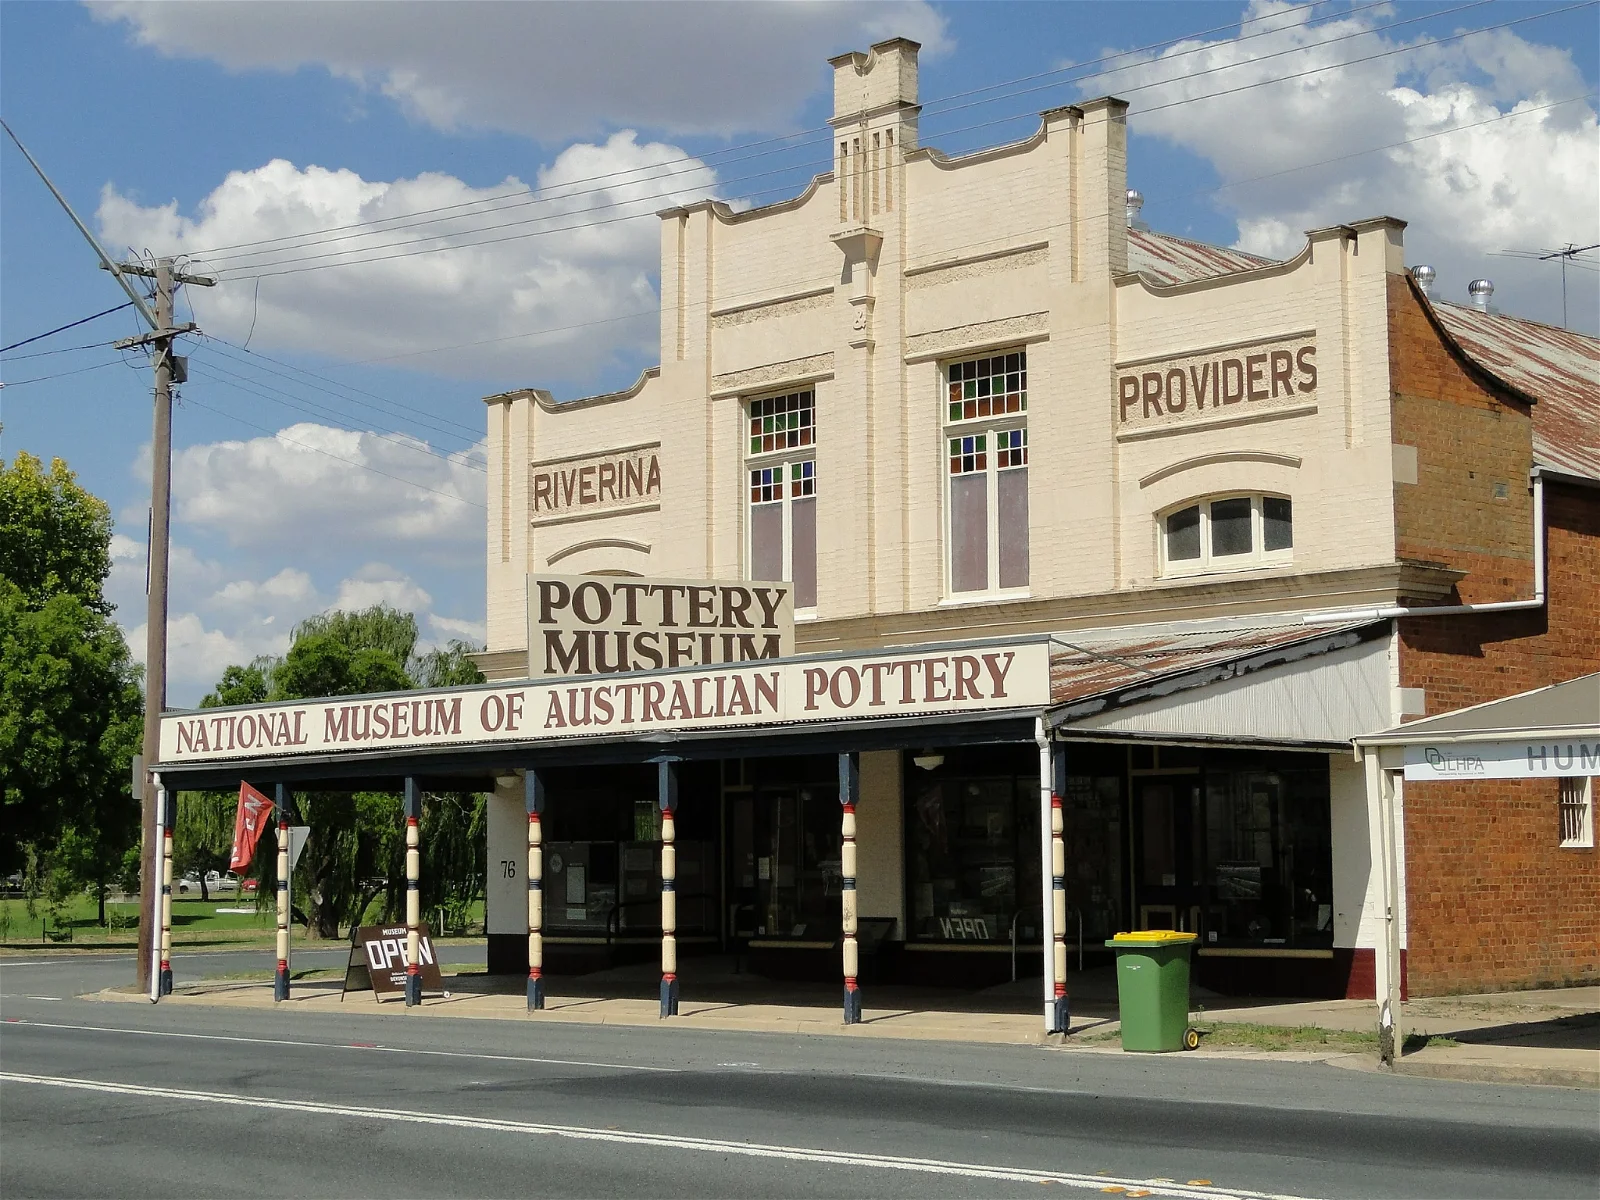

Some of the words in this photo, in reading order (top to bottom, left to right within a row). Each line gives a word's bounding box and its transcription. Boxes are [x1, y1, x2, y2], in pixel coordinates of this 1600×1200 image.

[1119, 345, 1318, 423] PROVIDERS
[534, 454, 661, 511] RIVERINA
[536, 580, 787, 629] POTTERY
[542, 629, 781, 675] MUSEUM
[176, 710, 308, 755] NATIONAL
[323, 697, 463, 744] MUSEUM
[480, 691, 526, 732] OF
[544, 671, 780, 730] AUSTRALIAN
[803, 651, 1016, 711] POTTERY
[1447, 757, 1484, 771] LHPA
[500, 861, 516, 879] 76
[366, 937, 434, 970] OPEN
[382, 928, 407, 936] MUSEUM
